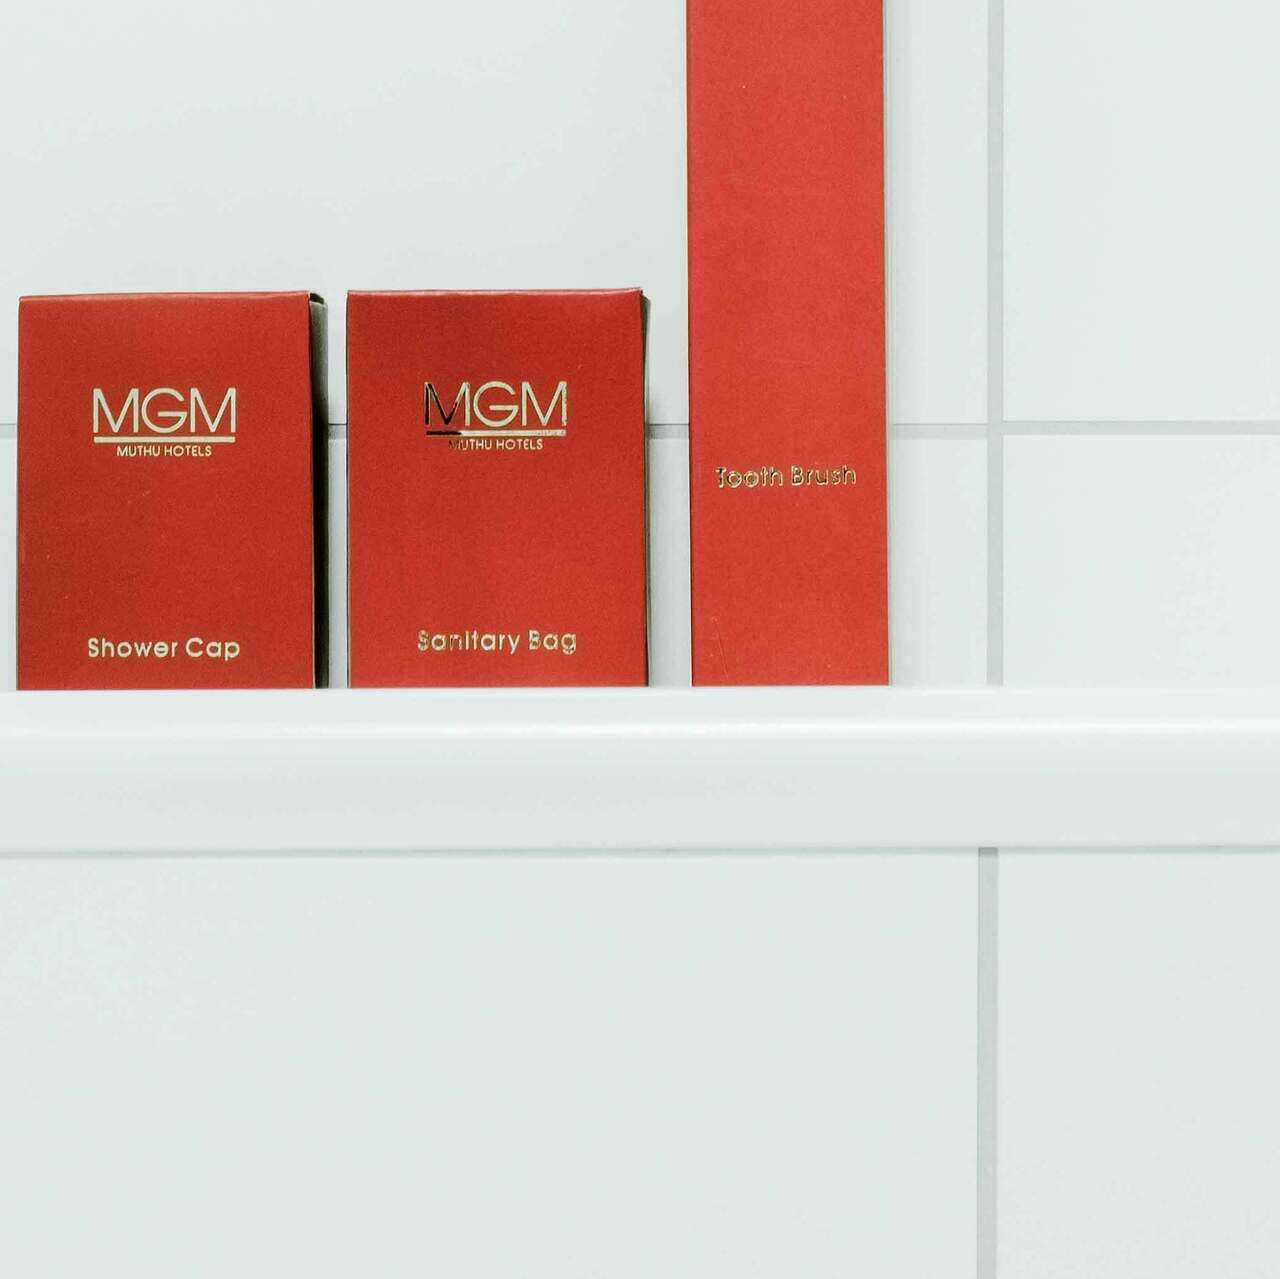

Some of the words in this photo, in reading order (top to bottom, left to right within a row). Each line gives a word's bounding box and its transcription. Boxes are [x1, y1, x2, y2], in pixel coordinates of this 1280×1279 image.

[93, 387, 237, 434] MGM
[423, 380, 568, 428] MGM
[116, 445, 161, 457] MUTHU
[164, 445, 212, 457] HOTELS
[448, 438, 492, 451] MUTHU
[495, 438, 544, 451] HOTELS
[715, 466, 784, 489] Tooth
[791, 464, 857, 486] Brush
[87, 637, 179, 658] Shower
[185, 637, 241, 662] Cap
[417, 629, 521, 655] Sanitary
[528, 629, 577, 655] Bag
